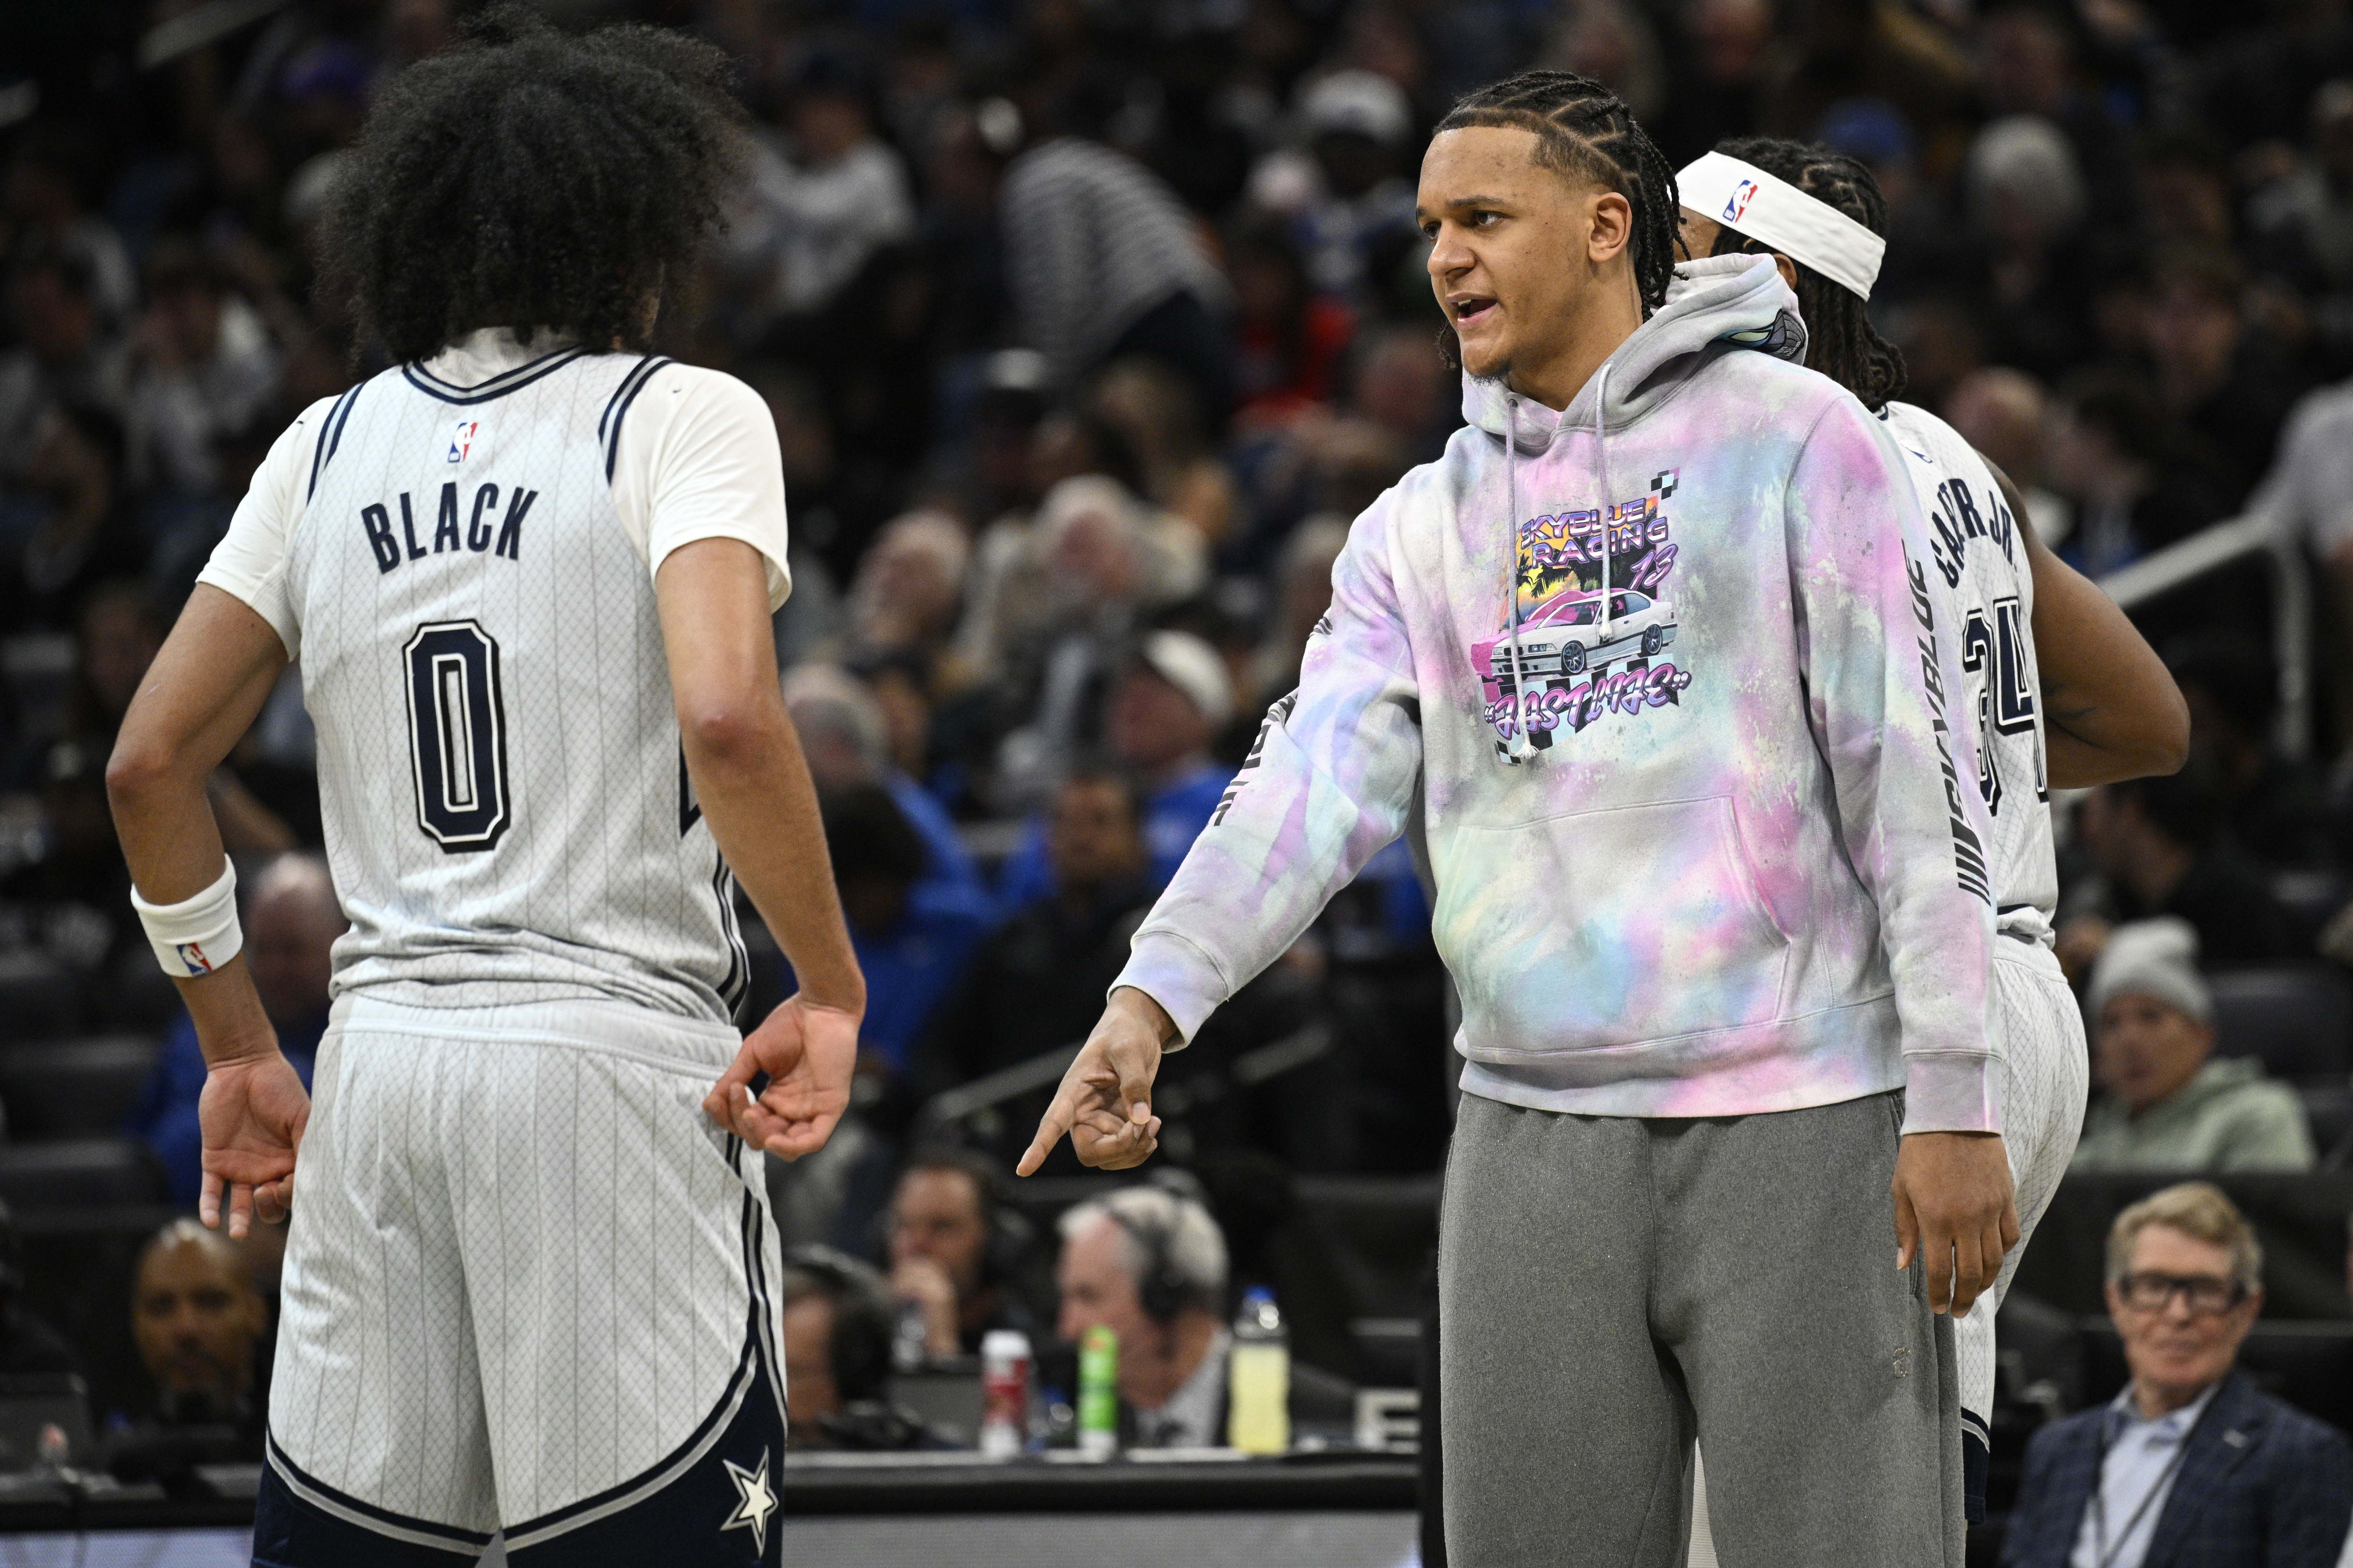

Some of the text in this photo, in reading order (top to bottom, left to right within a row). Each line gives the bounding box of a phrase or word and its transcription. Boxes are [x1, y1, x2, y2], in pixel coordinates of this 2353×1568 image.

[361, 482, 539, 575] BLACK
[1521, 498, 1646, 549] SKYBLUE
[1532, 516, 1668, 568] RACING
[1629, 544, 1678, 591] 13
[402, 618, 510, 854] 0
